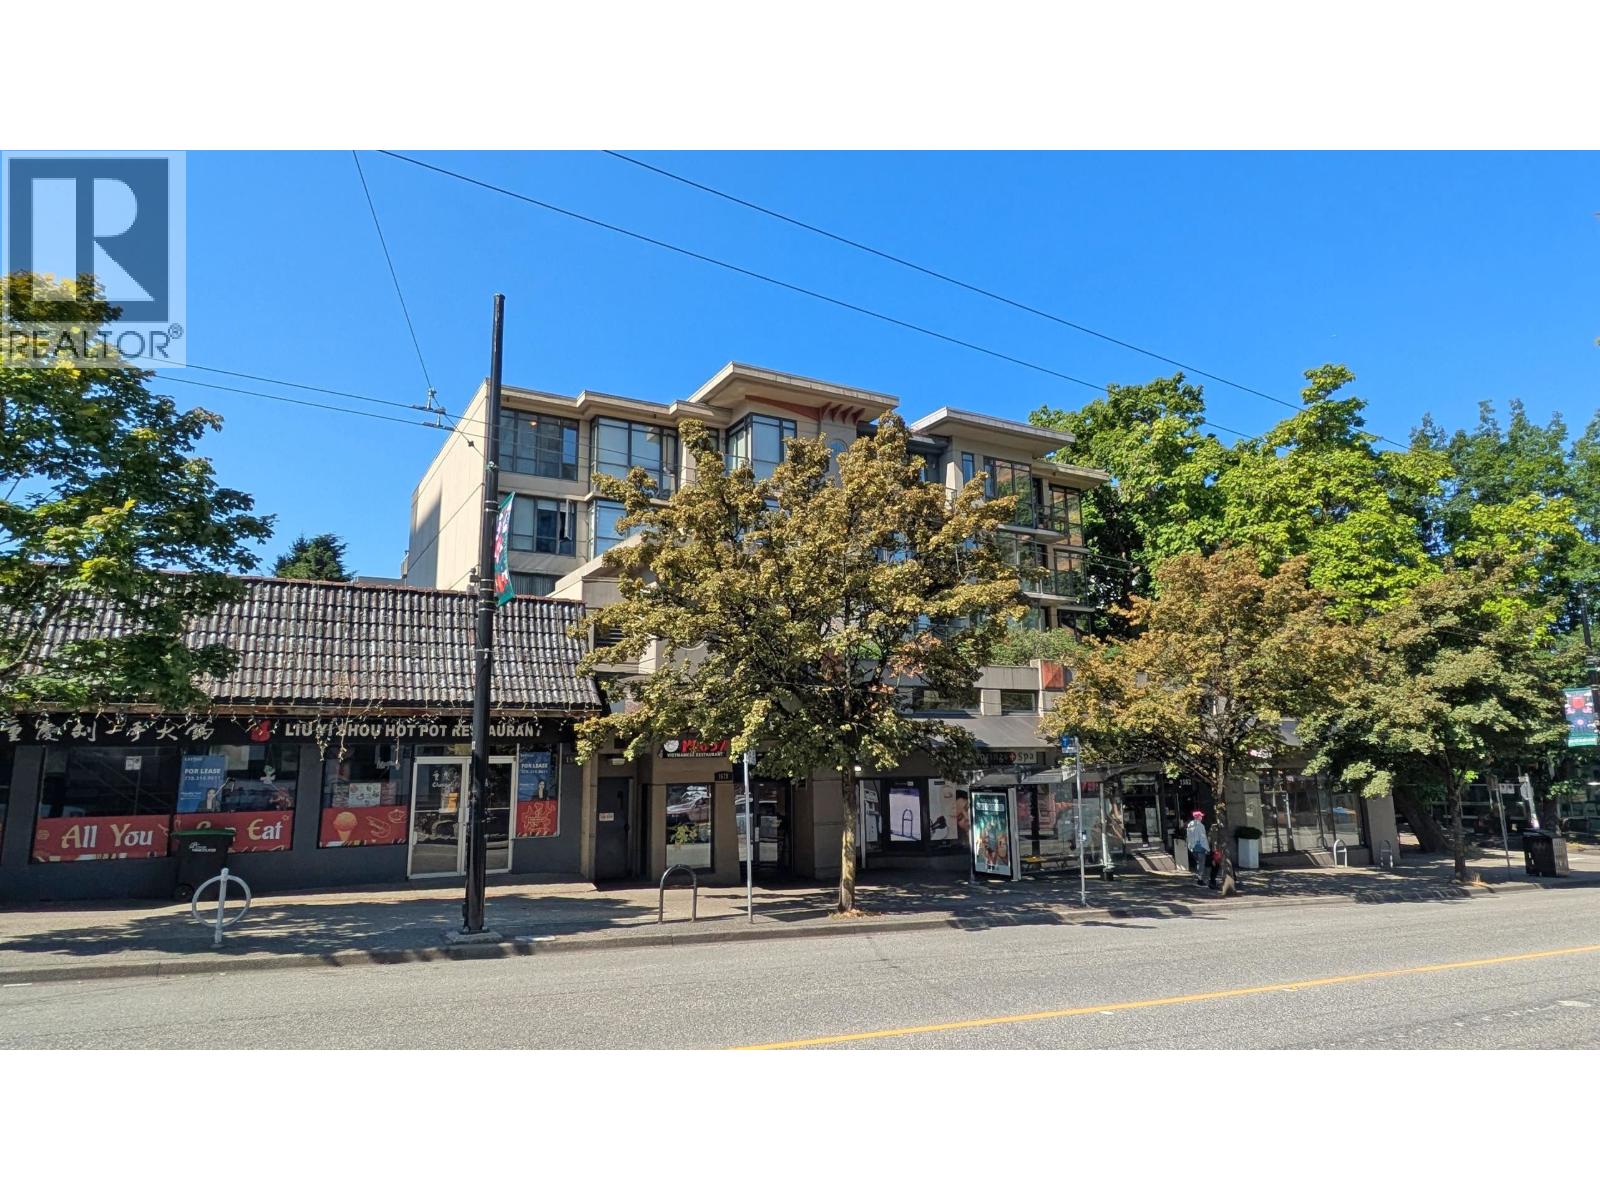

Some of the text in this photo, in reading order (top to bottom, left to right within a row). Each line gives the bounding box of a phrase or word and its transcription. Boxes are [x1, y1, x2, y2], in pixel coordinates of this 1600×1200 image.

[285, 723, 312, 737] LIU
[385, 724, 417, 737] HOT
[420, 724, 447, 737] POT
[452, 724, 543, 737] REAURANT
[61, 823, 154, 849] All You
[247, 818, 283, 841] Eat
